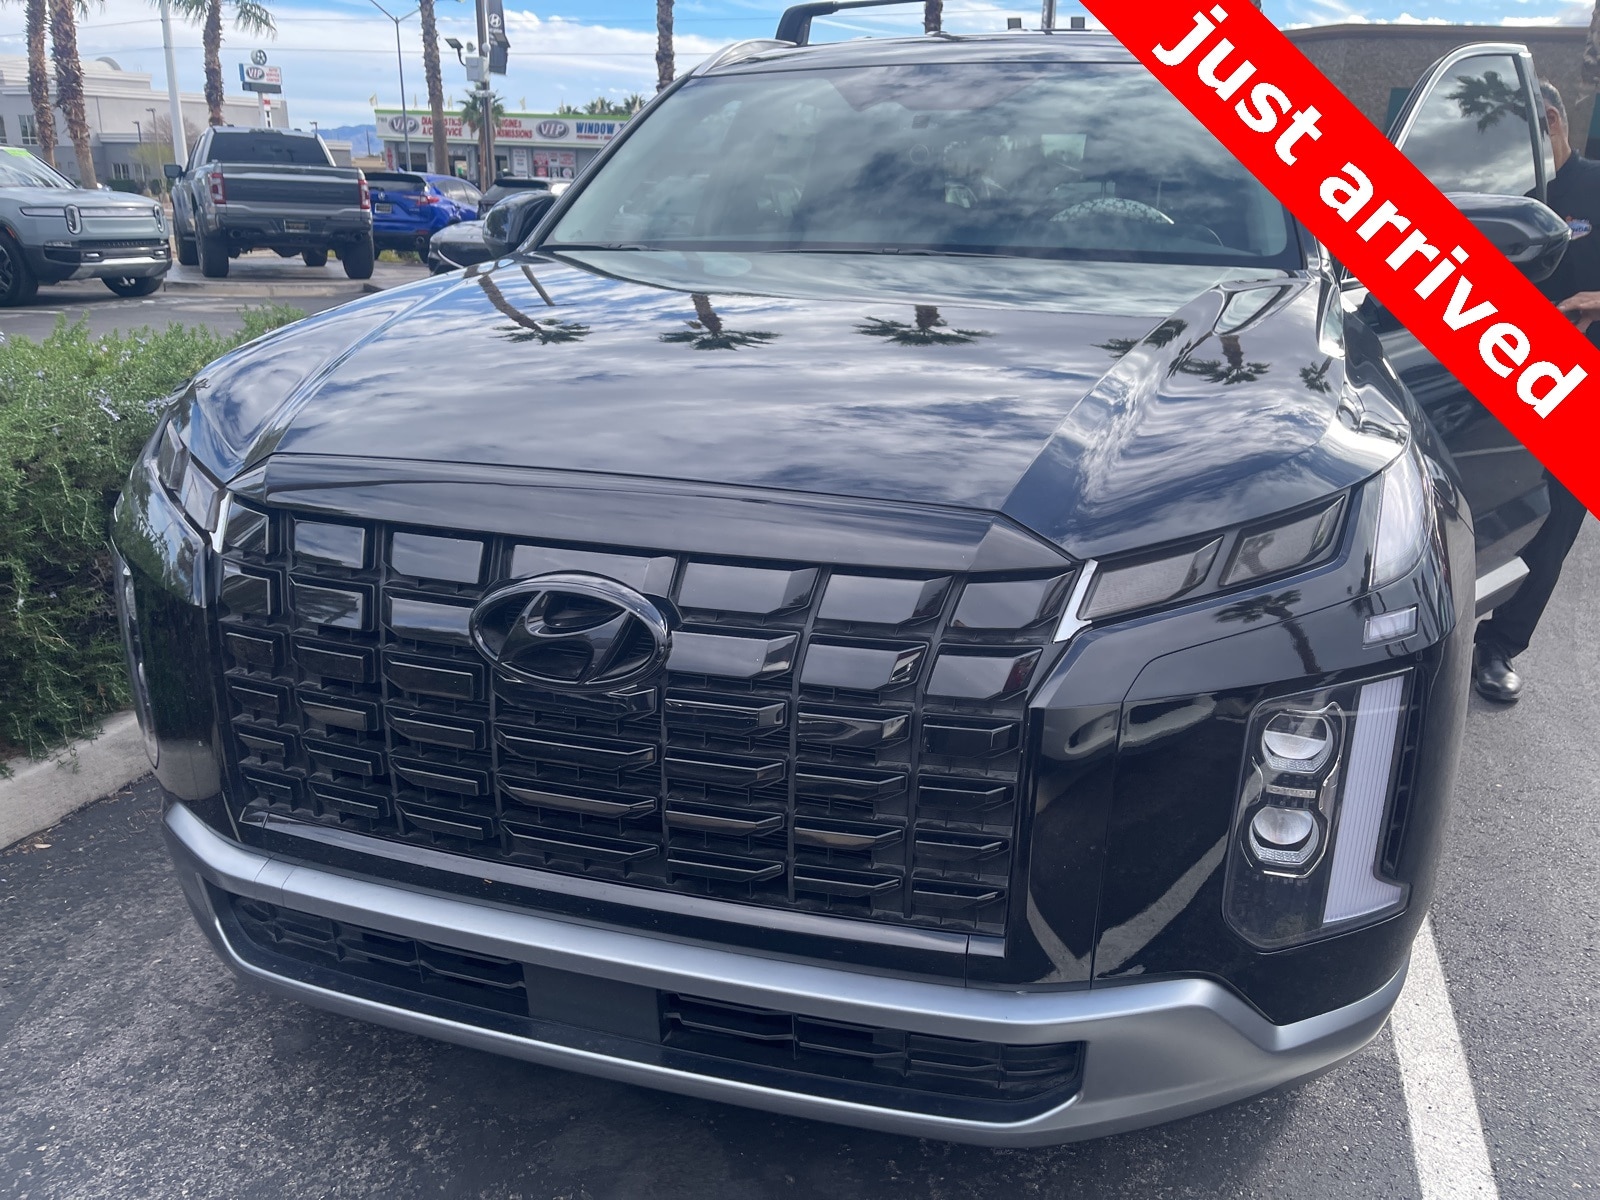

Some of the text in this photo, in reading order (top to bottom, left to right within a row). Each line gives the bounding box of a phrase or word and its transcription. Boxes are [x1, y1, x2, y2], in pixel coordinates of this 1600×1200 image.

[249, 67, 263, 79] VIP
[393, 119, 415, 132] VIP
[421, 116, 462, 126] DIASTICS
[496, 129, 533, 139] NSMISSIONS
[540, 123, 565, 135] VIP
[575, 122, 616, 134] WINDOW
